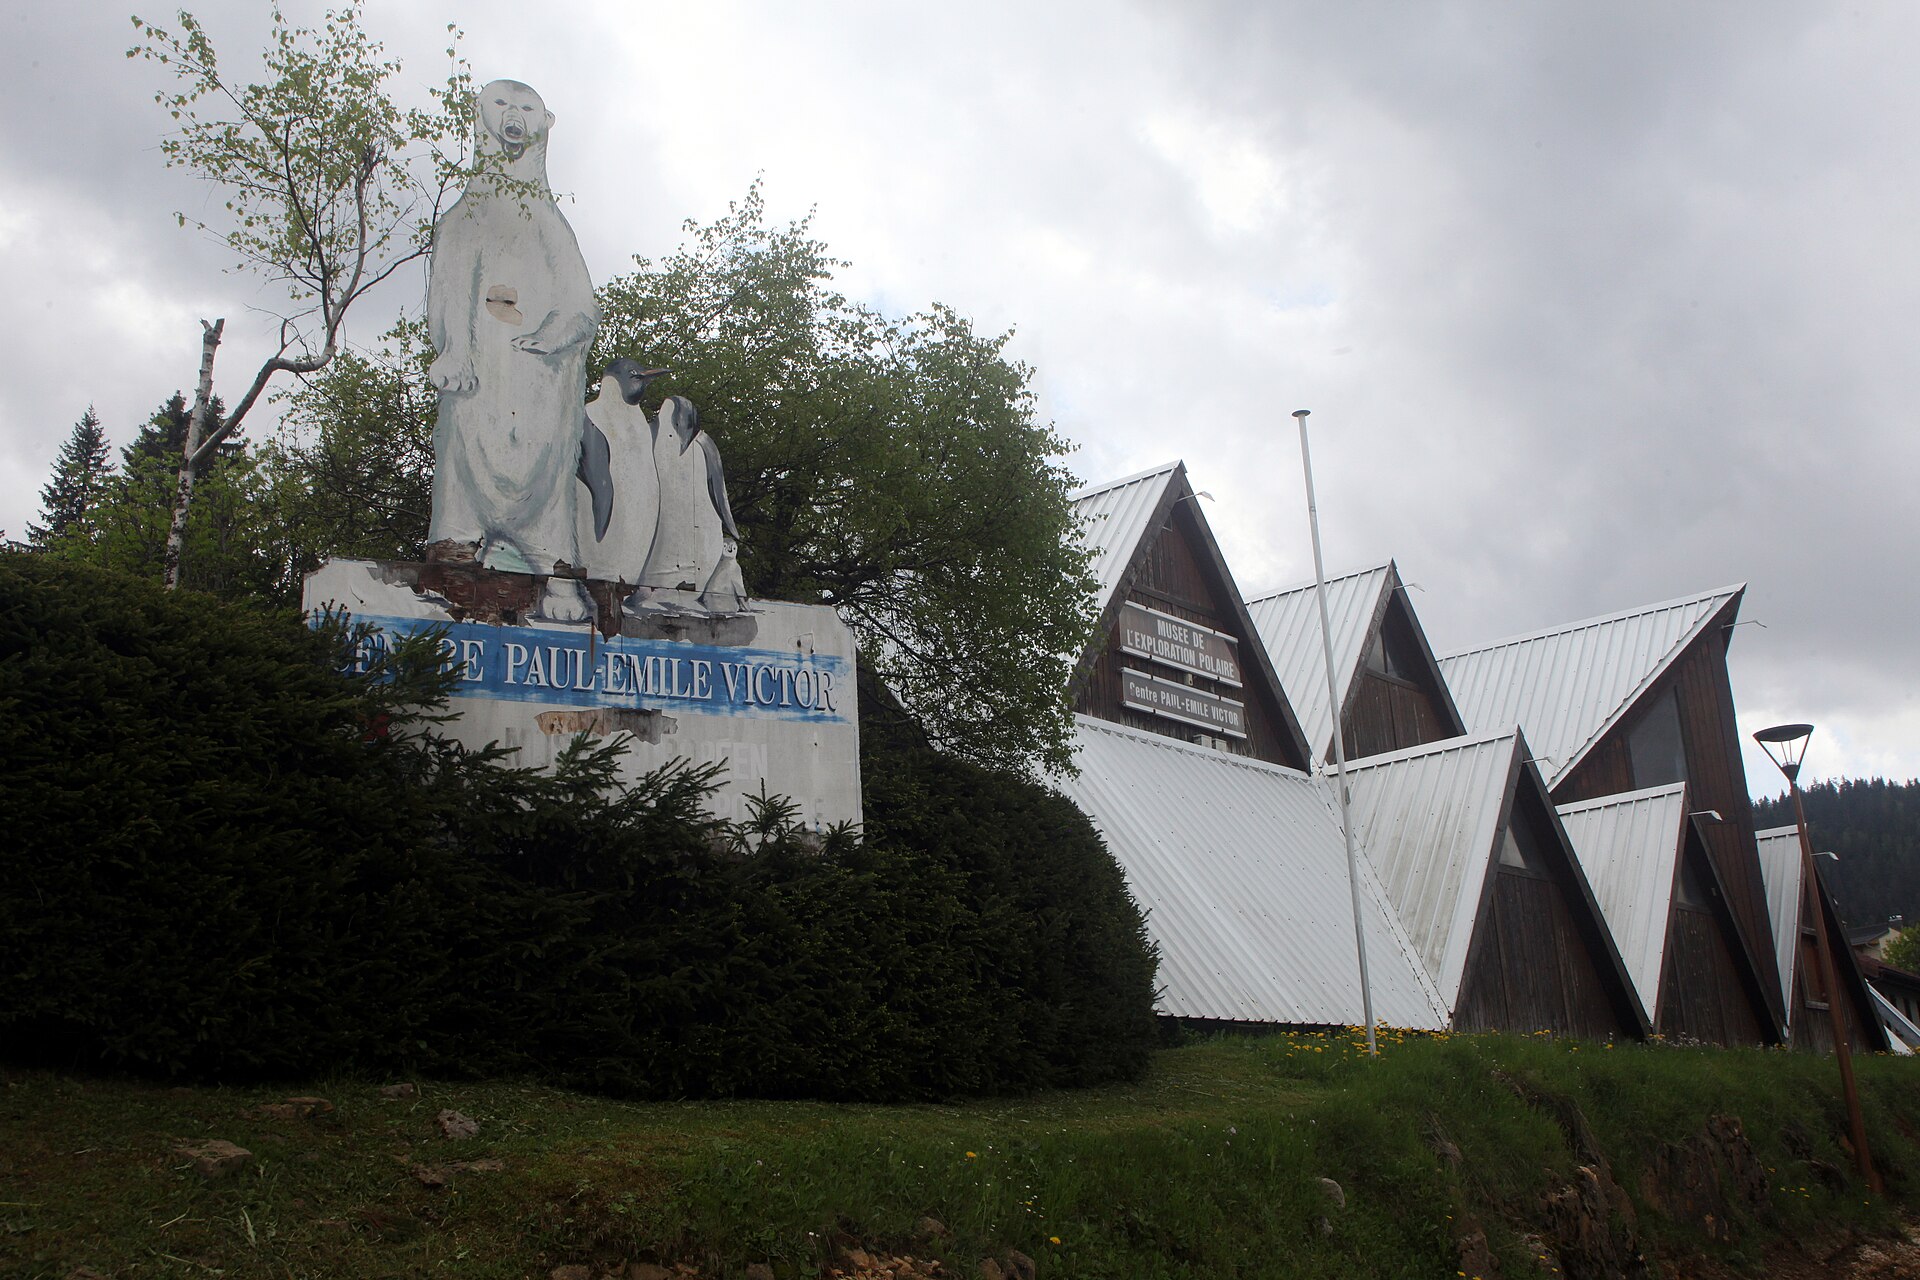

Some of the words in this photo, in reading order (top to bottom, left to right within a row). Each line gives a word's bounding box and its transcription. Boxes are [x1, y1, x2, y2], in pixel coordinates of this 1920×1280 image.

[1127, 629, 1196, 666] L'EXPLORATION
[1199, 654, 1234, 678] POLAIRE
[1157, 619, 1188, 644] MUSEE
[1193, 631, 1204, 650] DE
[332, 629, 484, 682] ENRE
[504, 641, 713, 700] PAUL-EMILE
[720, 661, 838, 711] VICTOR
[1129, 682, 1158, 702] Centre
[1161, 691, 1208, 717] PAUL-EMILE
[1211, 706, 1239, 726] VICTOR
